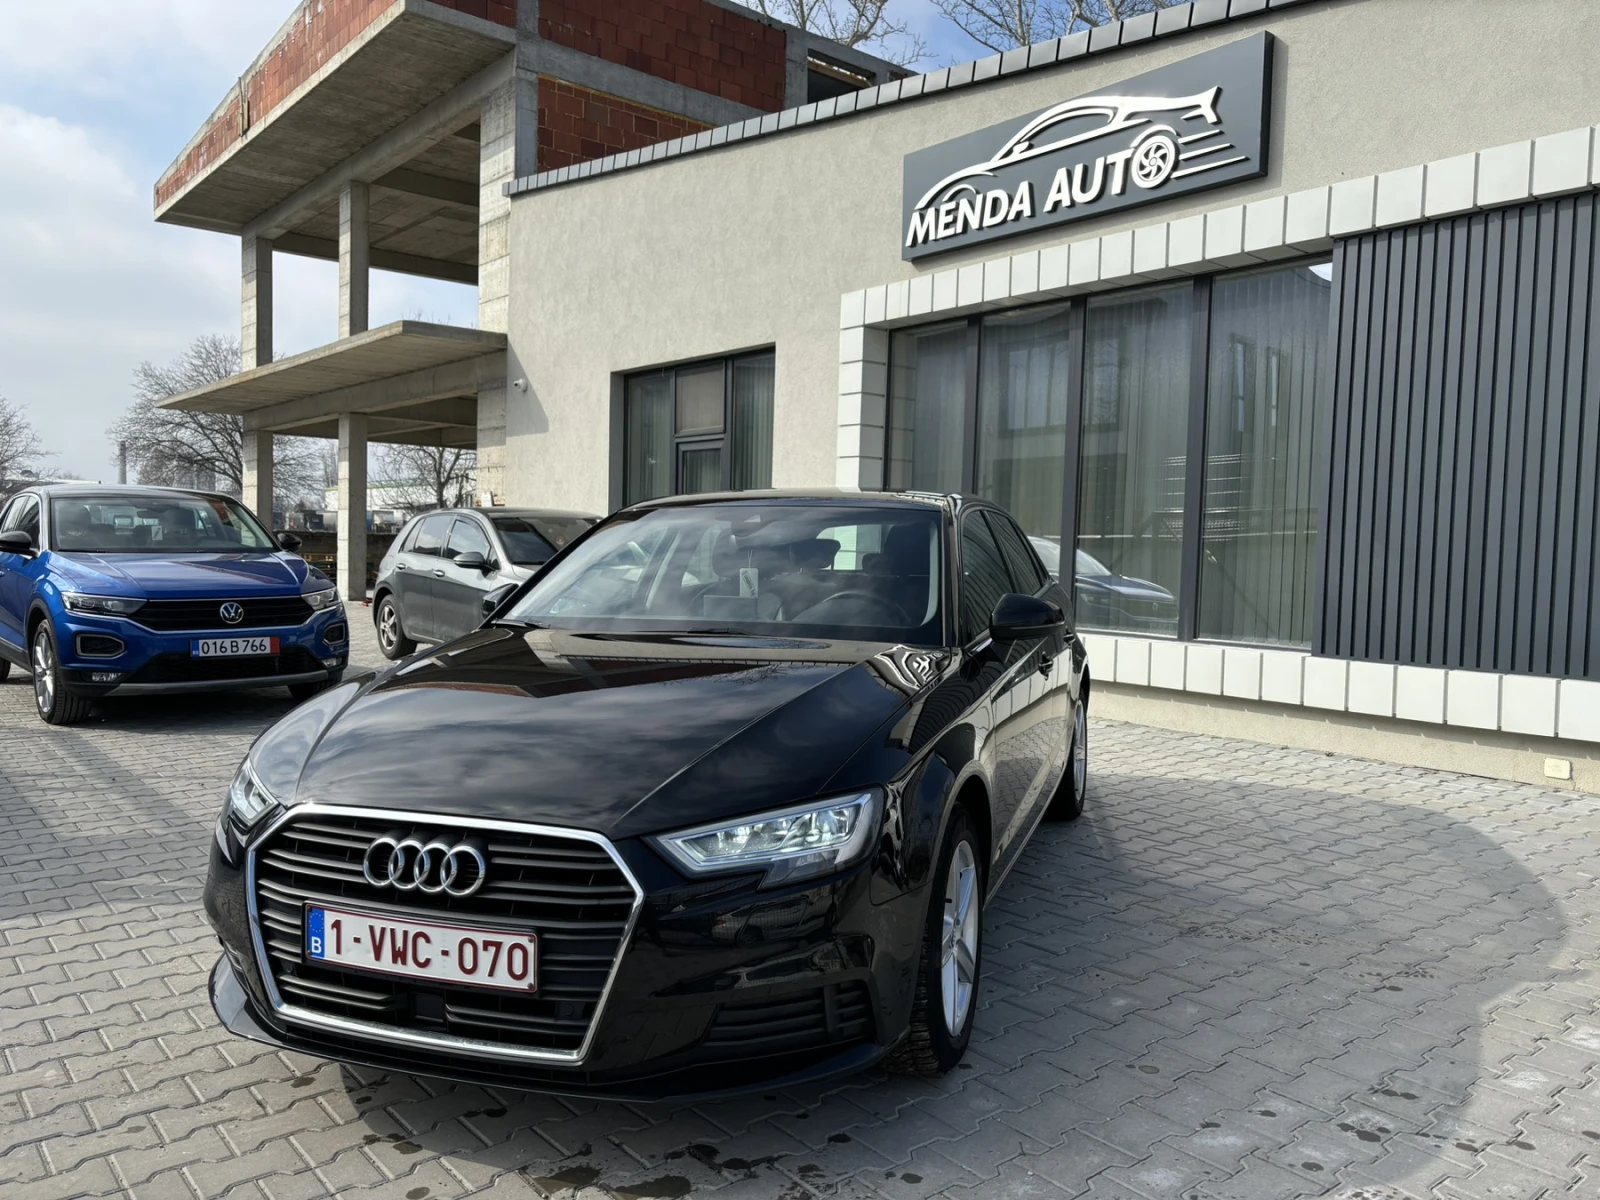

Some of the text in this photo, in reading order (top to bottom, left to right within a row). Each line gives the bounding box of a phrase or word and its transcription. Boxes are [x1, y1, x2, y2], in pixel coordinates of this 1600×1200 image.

[905, 135, 1178, 247] MENDA AUTO
[311, 936, 322, 954] B
